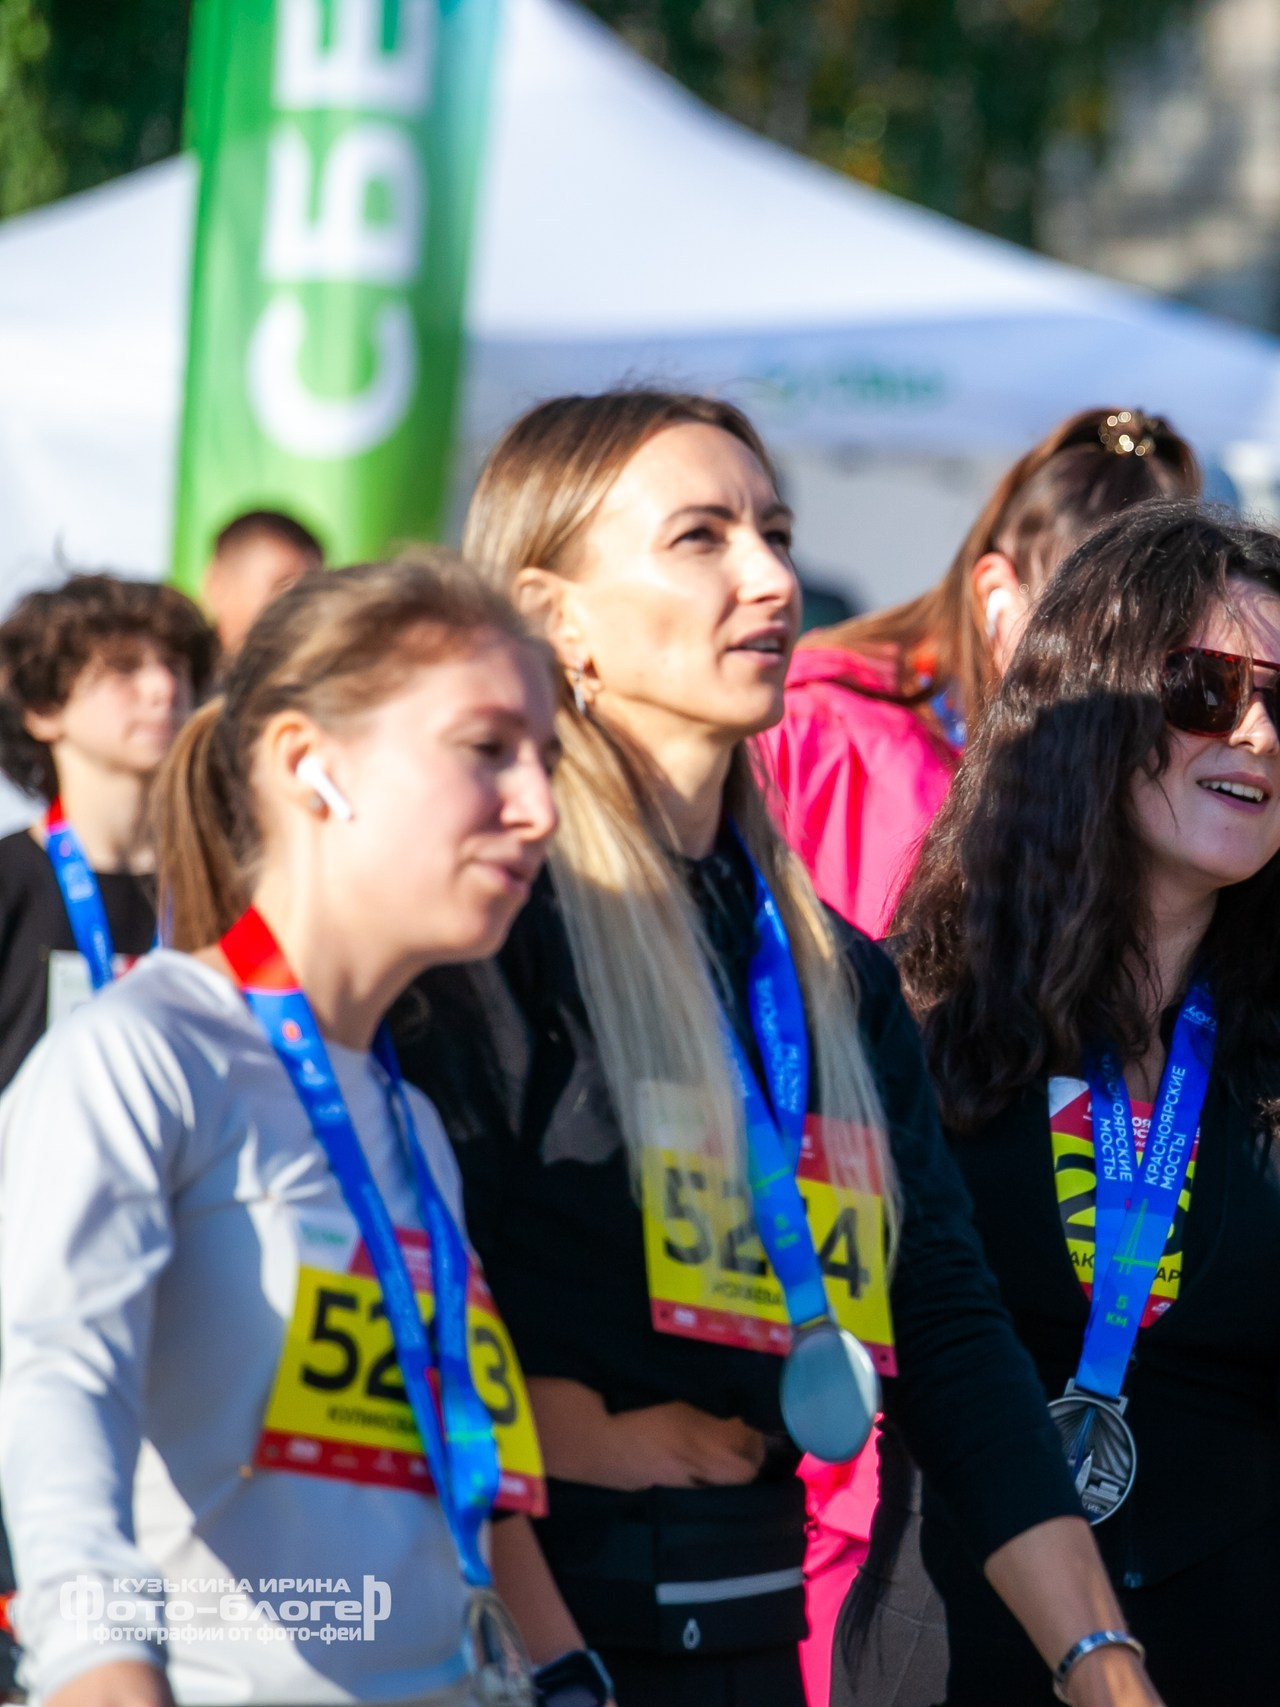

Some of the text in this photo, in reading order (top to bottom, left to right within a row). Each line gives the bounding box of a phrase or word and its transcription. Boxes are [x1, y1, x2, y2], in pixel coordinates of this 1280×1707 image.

[1099, 1117, 1117, 1181] МОСТЫ
[1144, 1065, 1186, 1185] КРАСНОЯРСКИЕ
[1159, 1132, 1187, 1190] МОСТЫ
